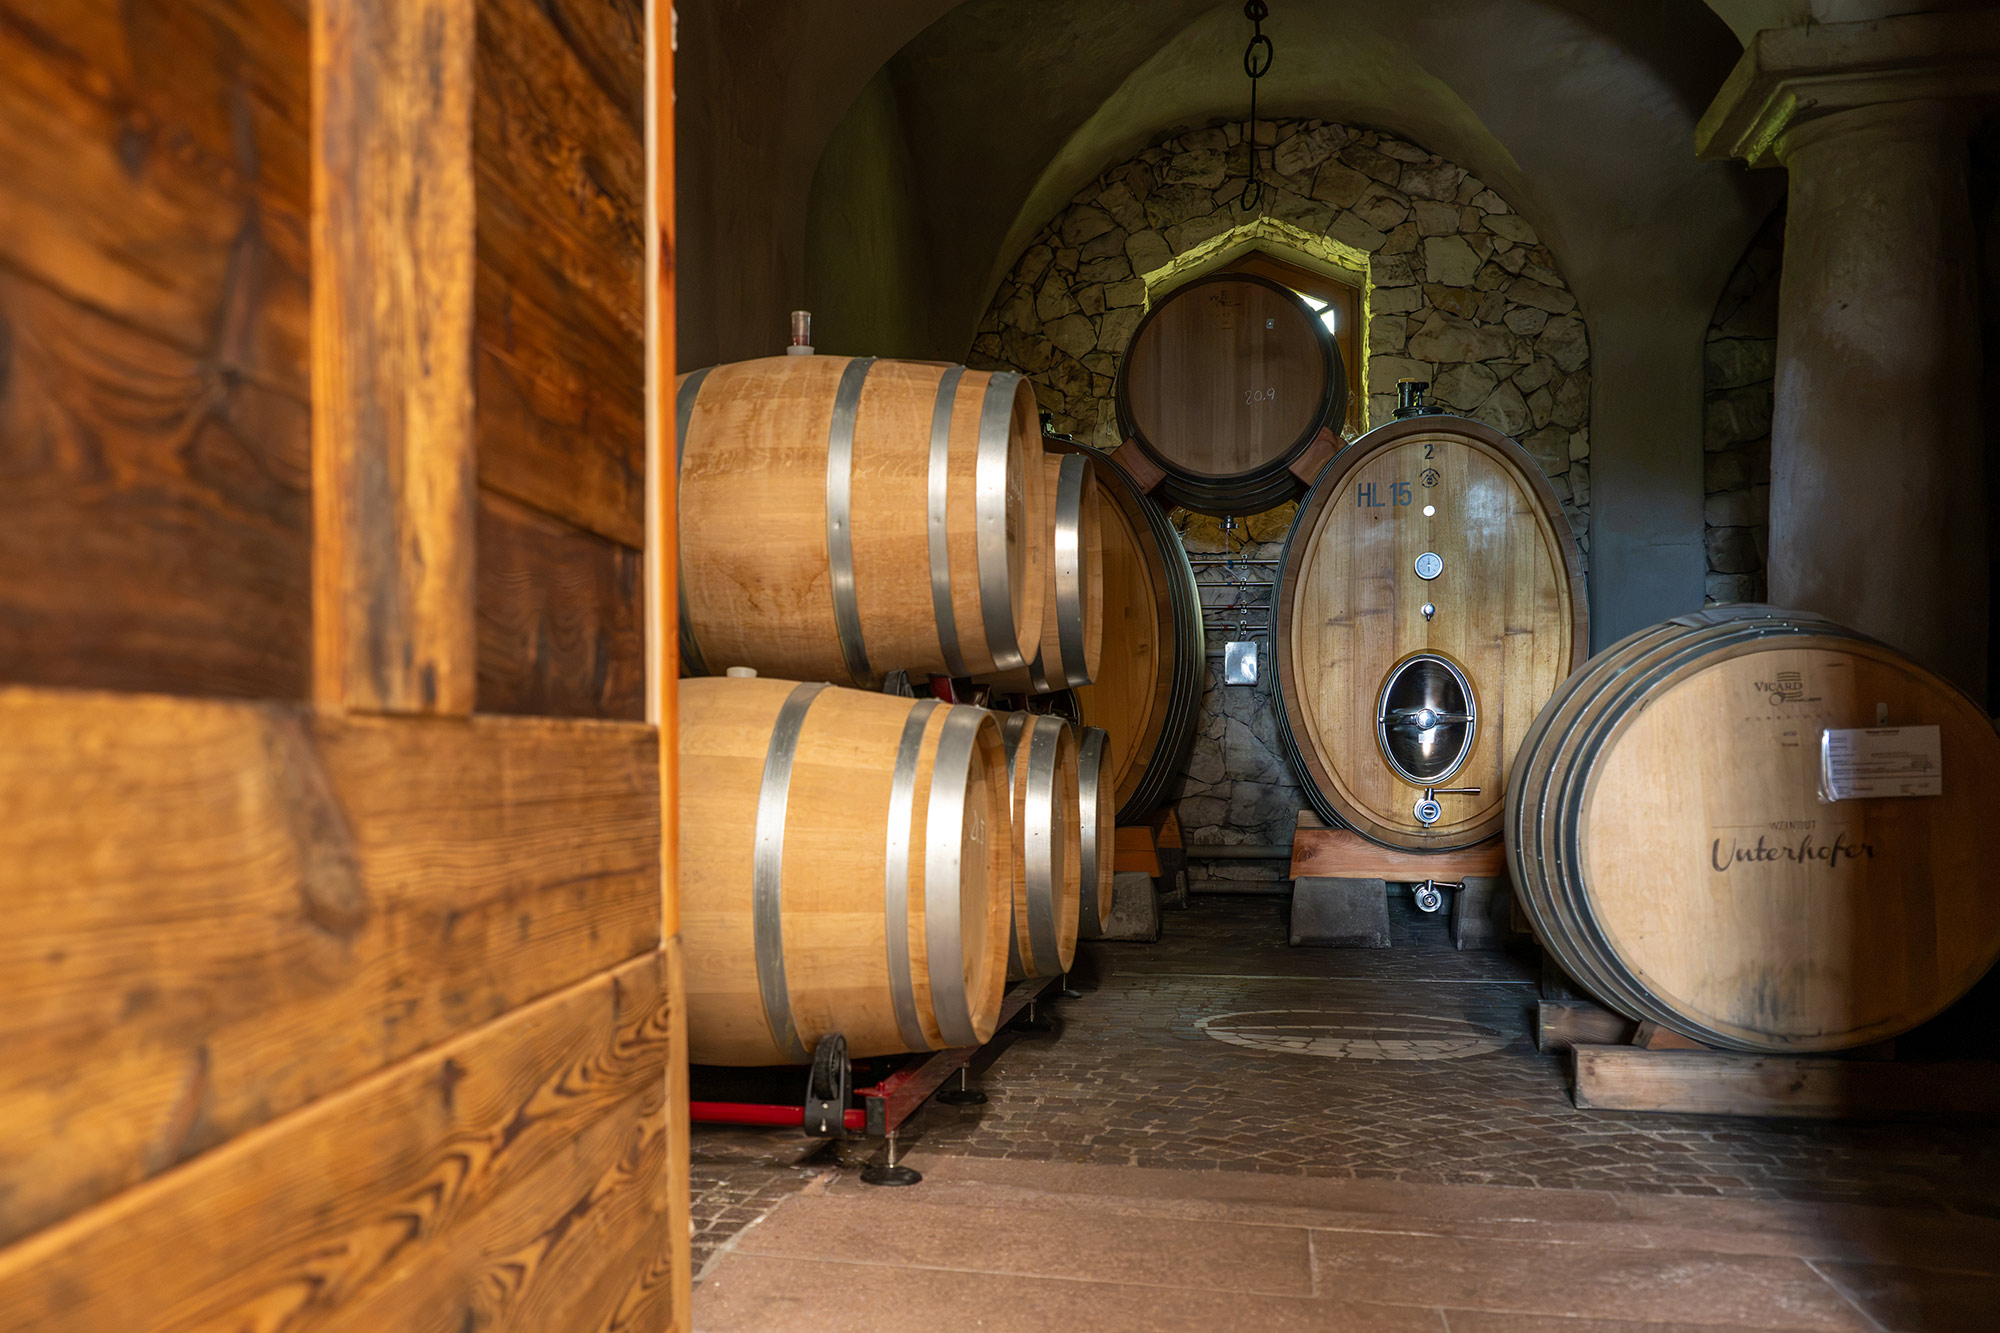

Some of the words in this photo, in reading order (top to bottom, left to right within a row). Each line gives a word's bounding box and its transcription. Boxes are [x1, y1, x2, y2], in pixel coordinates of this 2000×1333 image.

[1423, 443, 1435, 460] 2
[1357, 482, 1386, 508] HL
[1389, 481, 1413, 507] 15
[1711, 834, 1875, 872] Unterhofer
